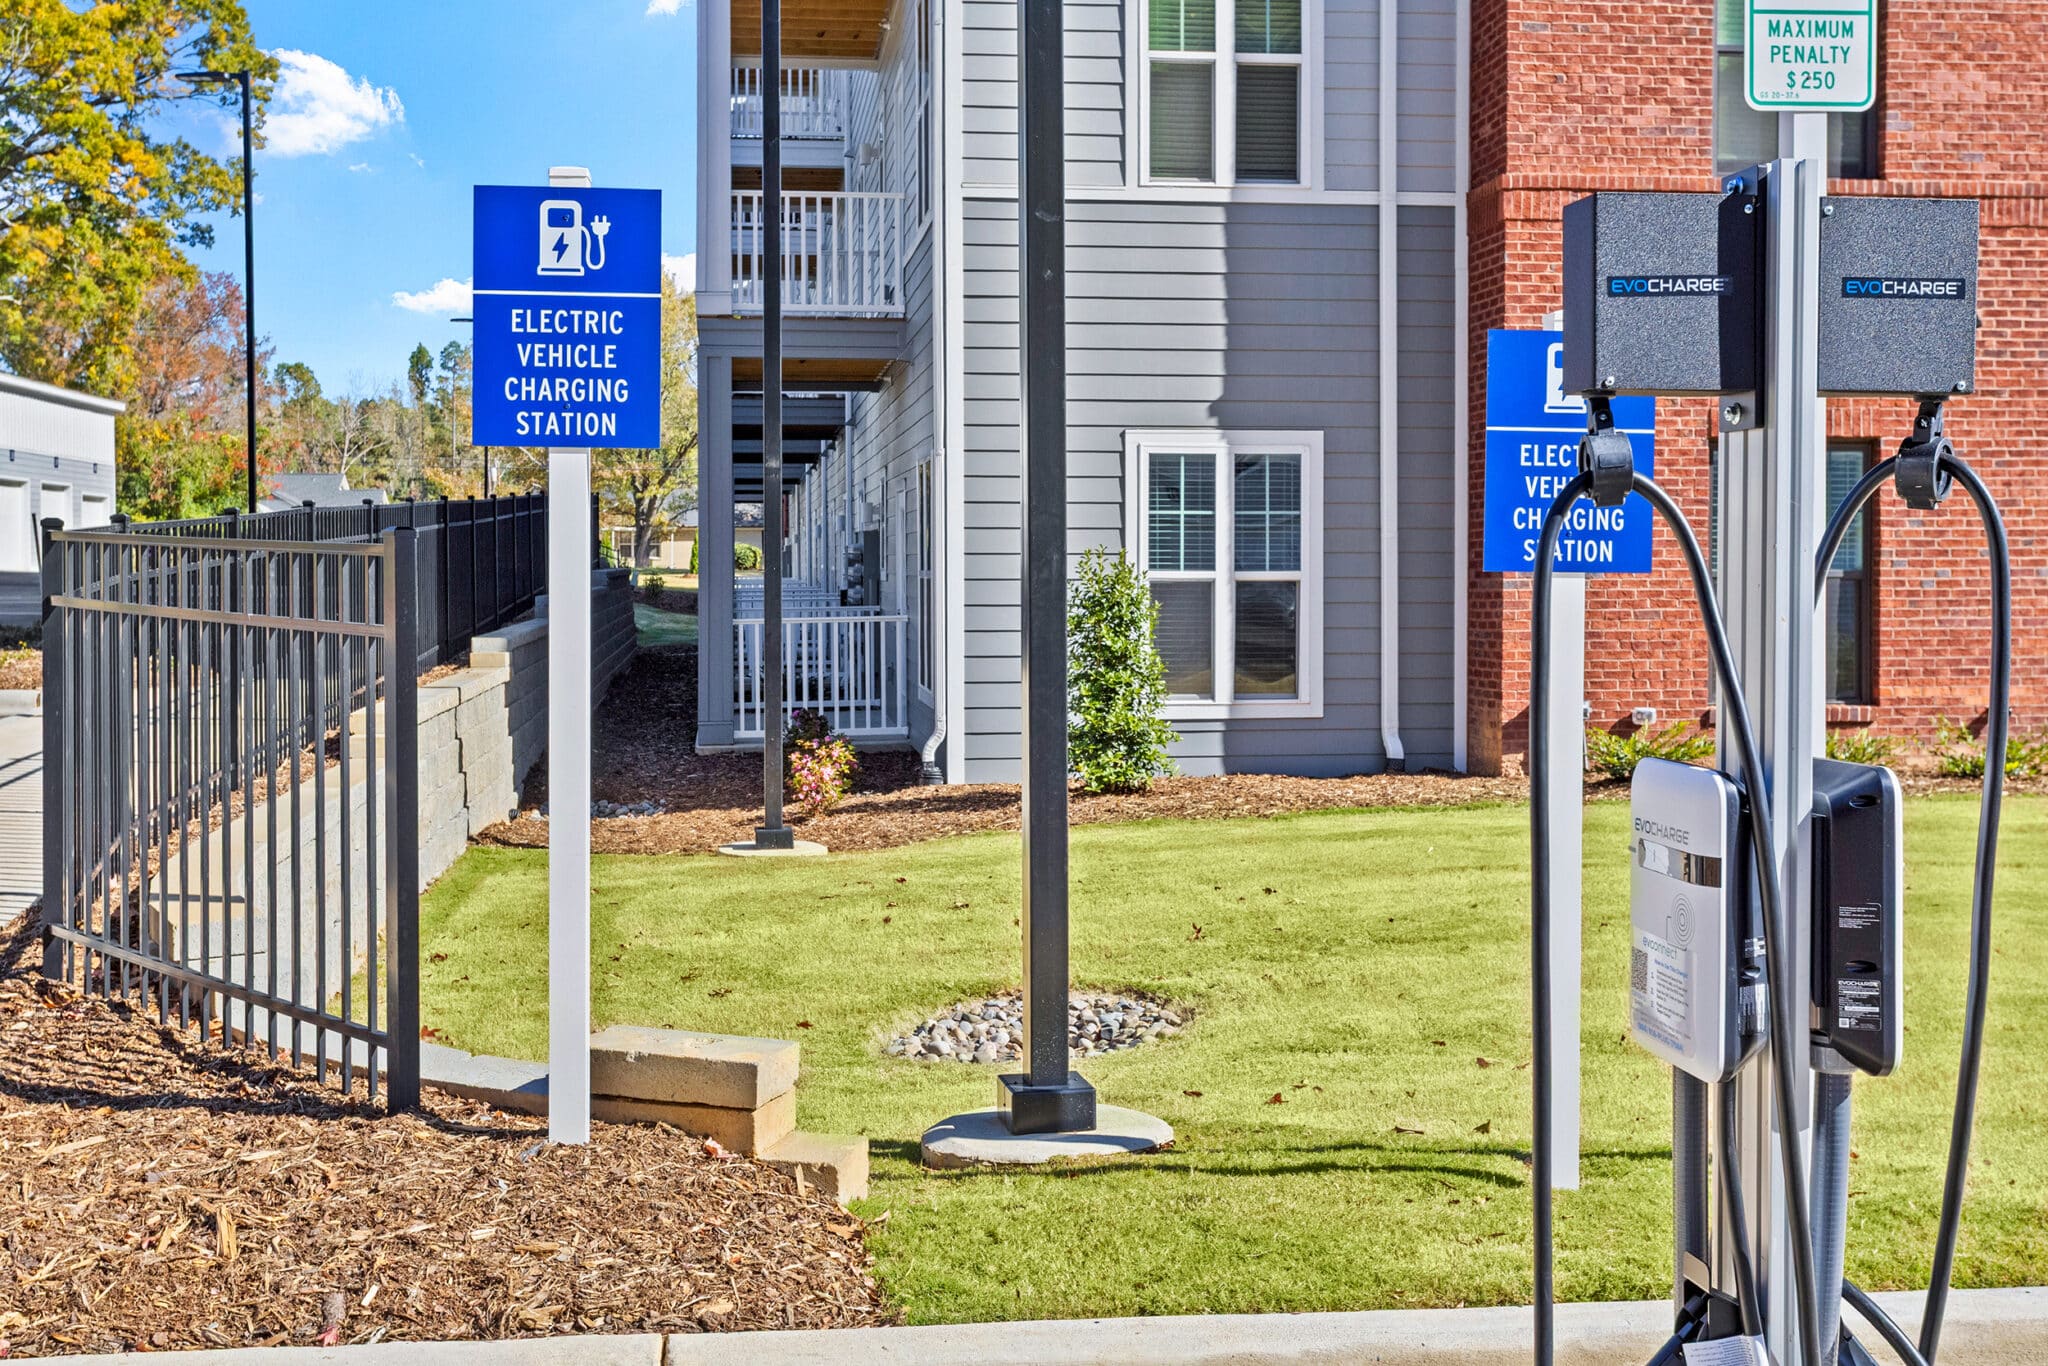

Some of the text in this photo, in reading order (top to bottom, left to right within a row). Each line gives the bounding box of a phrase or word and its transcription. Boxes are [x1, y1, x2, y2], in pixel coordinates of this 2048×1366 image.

[1768, 19, 1854, 38] MAXIMUM
[1770, 45, 1851, 64] PENALTY
[1786, 70, 1835, 89] $250
[1611, 278, 1724, 293] EVOCHARGE
[1846, 280, 1958, 295] EVOCHARGE
[511, 309, 624, 335] ELECTRIC
[517, 343, 617, 369] VEHICLE
[504, 377, 629, 403] CHARGING
[516, 411, 617, 436] STATION
[1513, 507, 1625, 531] CHRGING
[1523, 539, 1613, 563] SATION
[1635, 817, 1690, 845] EVOCHARGE
